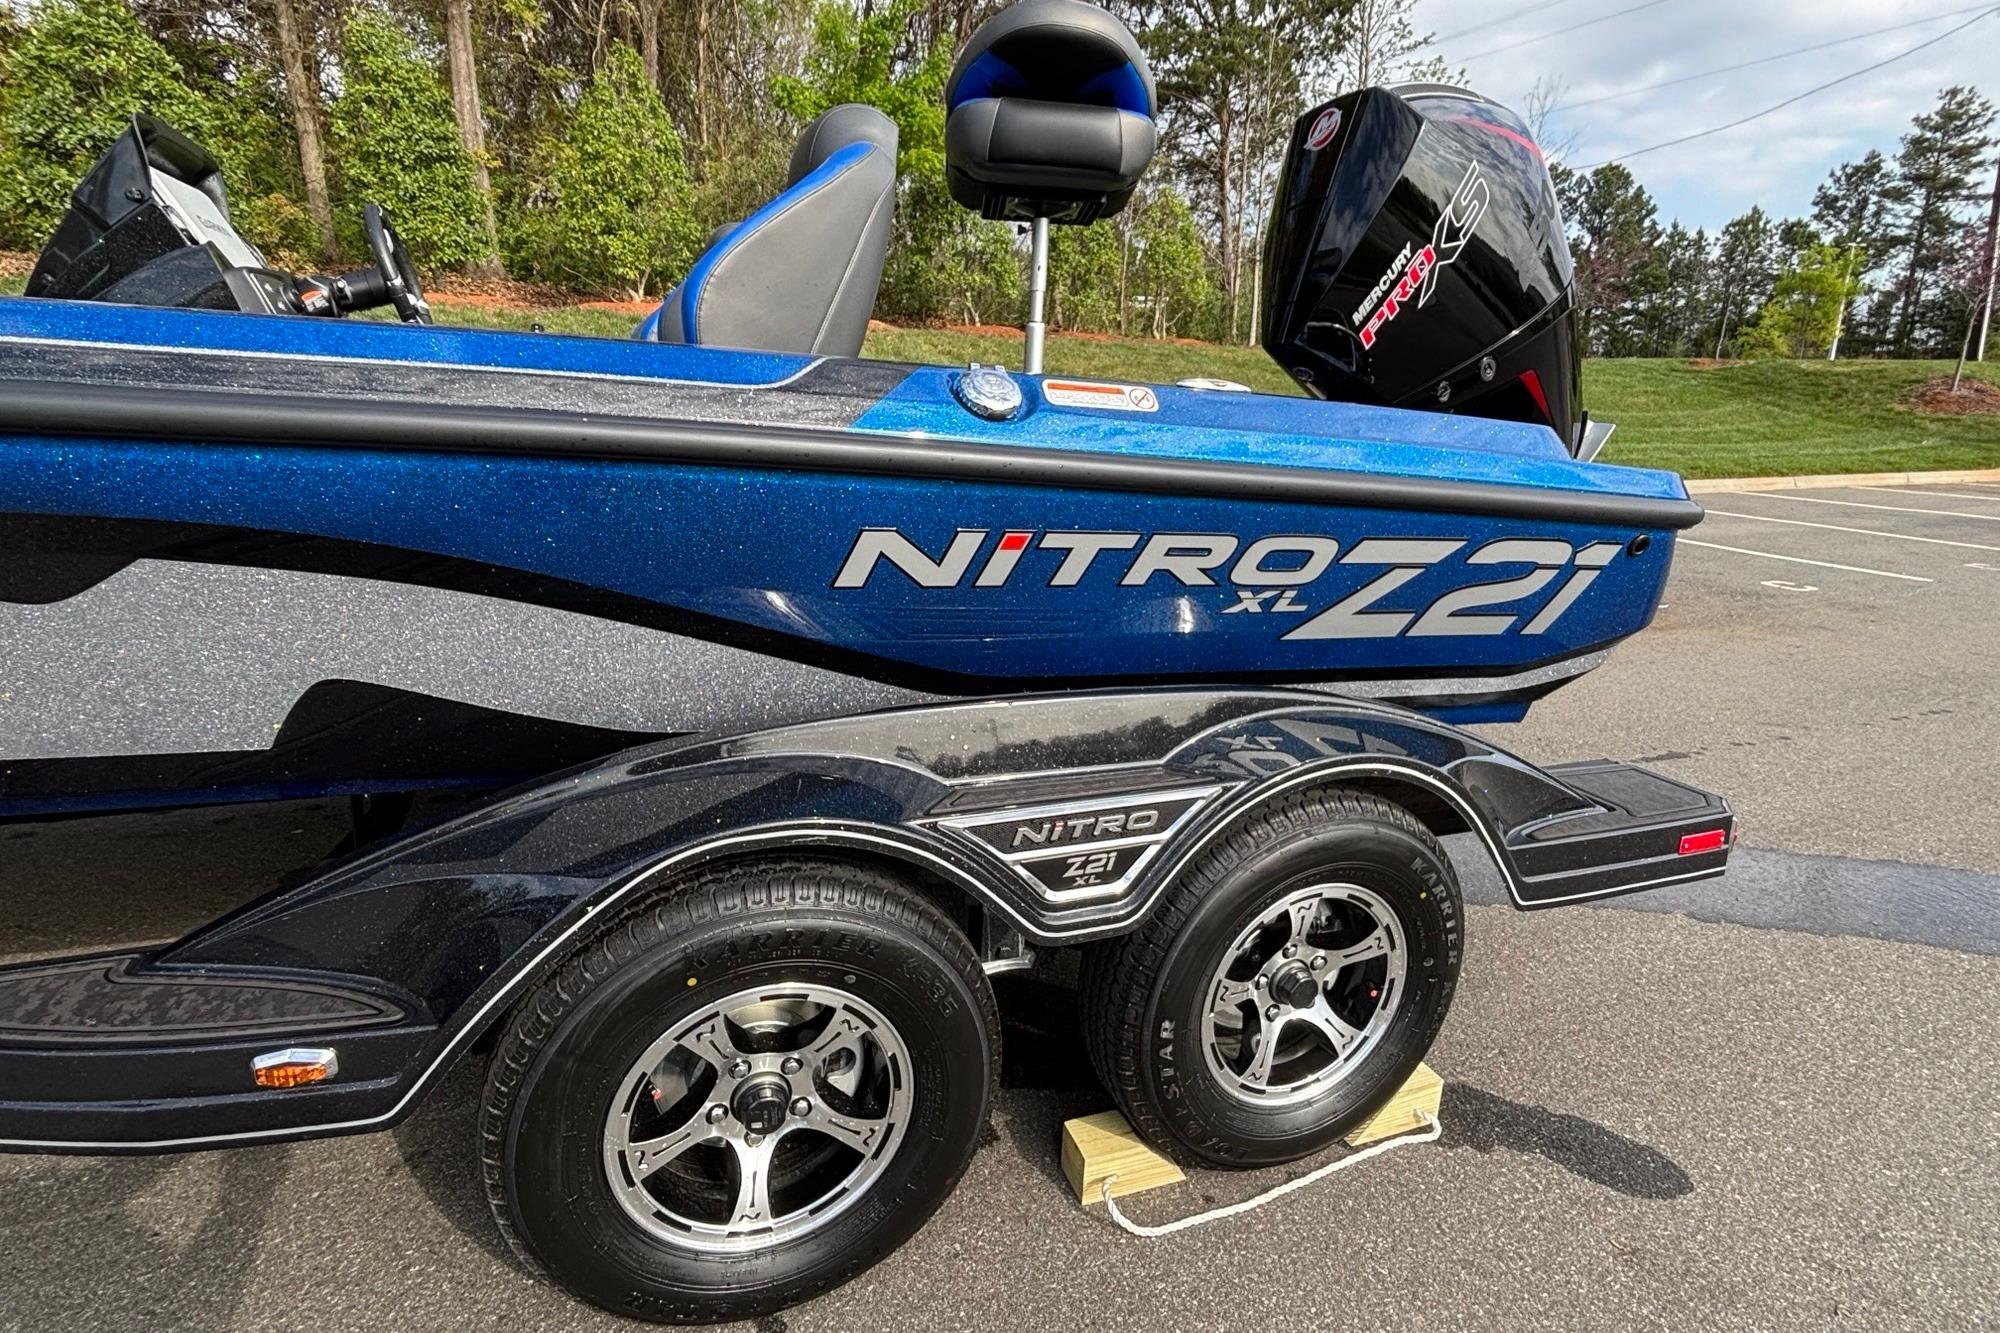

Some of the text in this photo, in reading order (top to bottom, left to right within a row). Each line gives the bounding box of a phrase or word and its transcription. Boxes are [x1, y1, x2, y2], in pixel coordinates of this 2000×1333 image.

[1351, 240, 1413, 327] MERCURY
[1359, 159, 1490, 350] PRO XS
[1220, 589, 1309, 614] XL
[1279, 536, 1623, 640] Z21
[1062, 851, 1118, 878] Z21
[1072, 875, 1103, 887] XL
[1410, 856, 1458, 966] KARRIER
[685, 929, 882, 970] KARRIER
